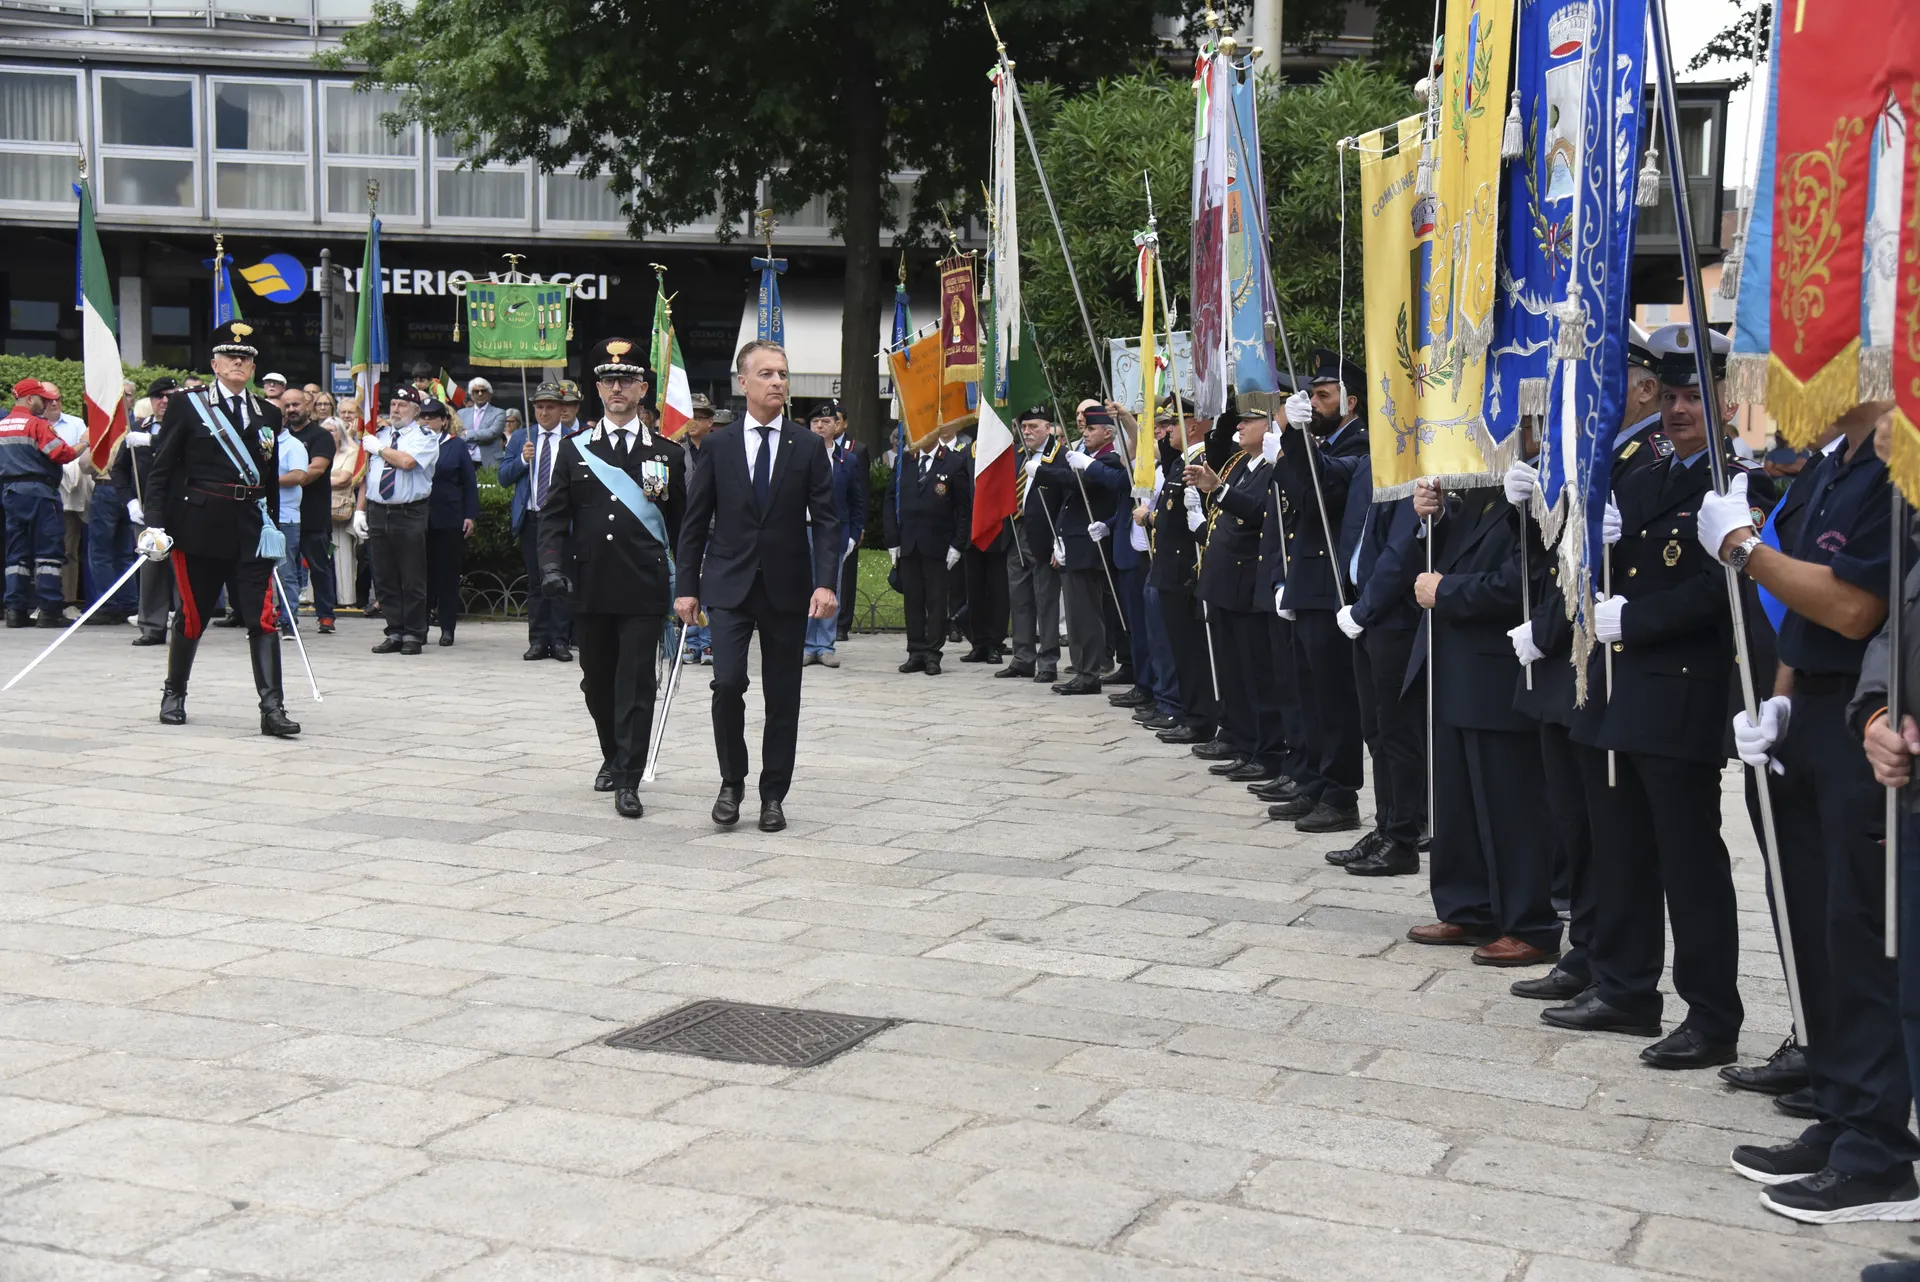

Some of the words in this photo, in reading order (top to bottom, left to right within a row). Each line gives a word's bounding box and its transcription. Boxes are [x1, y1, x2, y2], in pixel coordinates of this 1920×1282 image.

[1371, 169, 1416, 218] COMUNE
[772, 306, 781, 333] COMO
[477, 339, 513, 350] SEZIONE
[519, 340, 528, 350] DI
